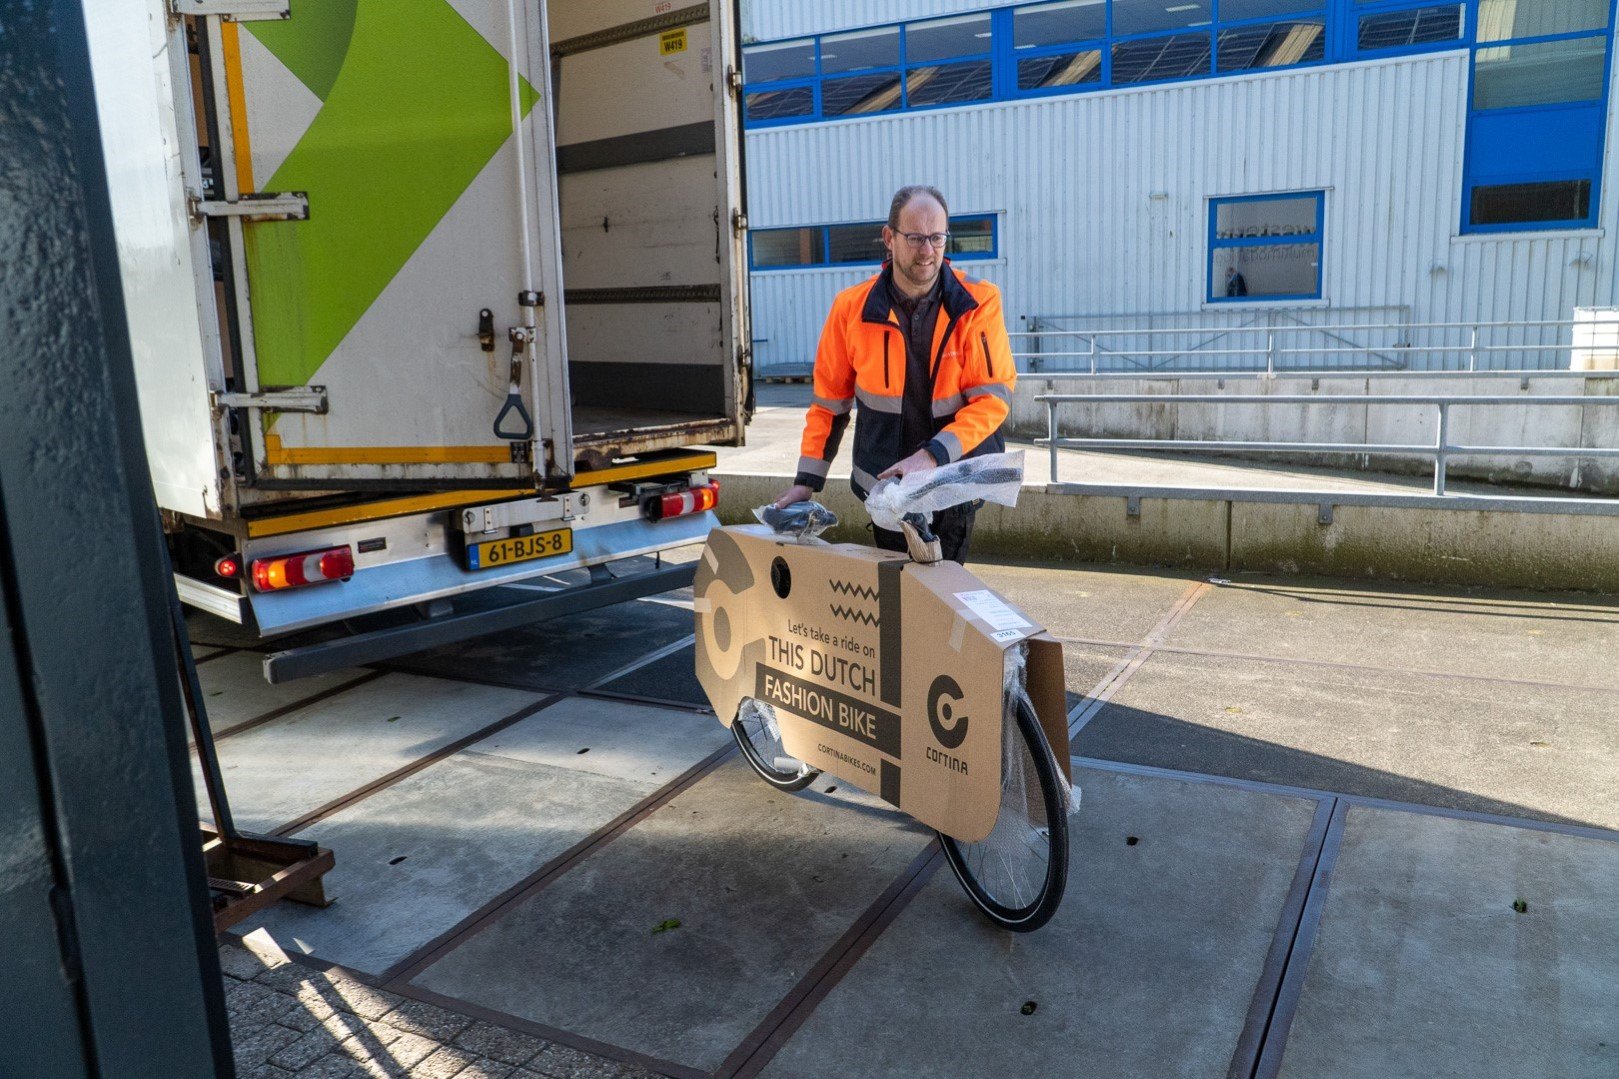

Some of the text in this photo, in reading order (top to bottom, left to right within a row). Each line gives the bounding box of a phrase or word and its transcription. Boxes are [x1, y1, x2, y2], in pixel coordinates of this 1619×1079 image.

[663, 38, 683, 52] W419
[488, 533, 563, 563] 61-BJS-8
[788, 618, 875, 659] Let's take a ride on
[768, 635, 876, 696] THIS DUTCH
[765, 674, 877, 740] FASHION BIKE
[817, 743, 877, 776] CORTINABIKES.COM
